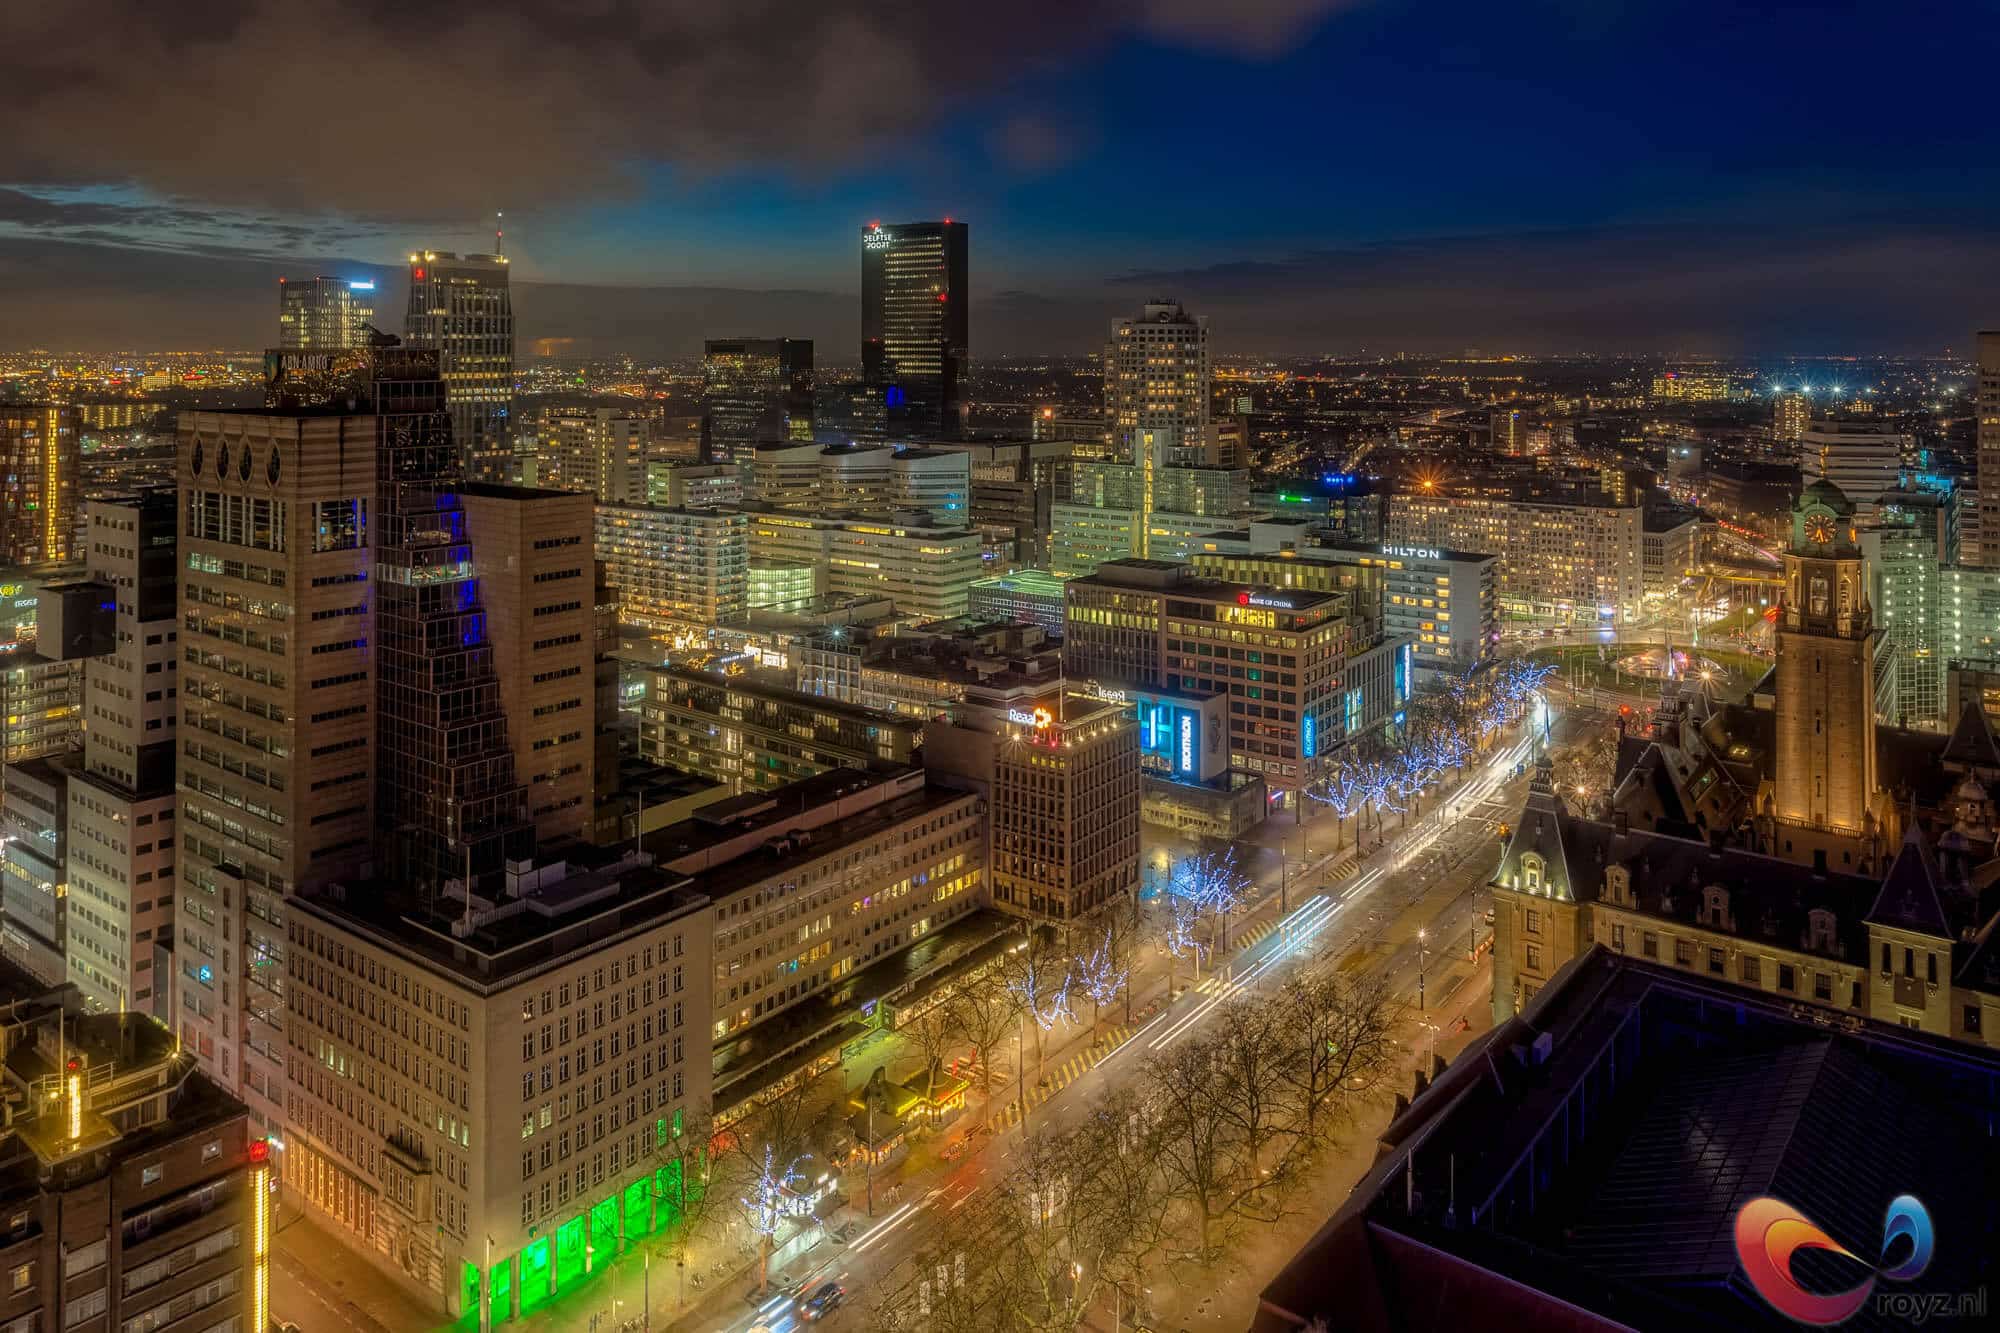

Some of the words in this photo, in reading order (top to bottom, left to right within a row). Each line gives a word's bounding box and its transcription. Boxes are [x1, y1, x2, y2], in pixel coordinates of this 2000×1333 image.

[1383, 545, 1439, 559] HILTON
[1009, 708, 1036, 725] Reaal
[1182, 715, 1191, 771] DECATHLON
